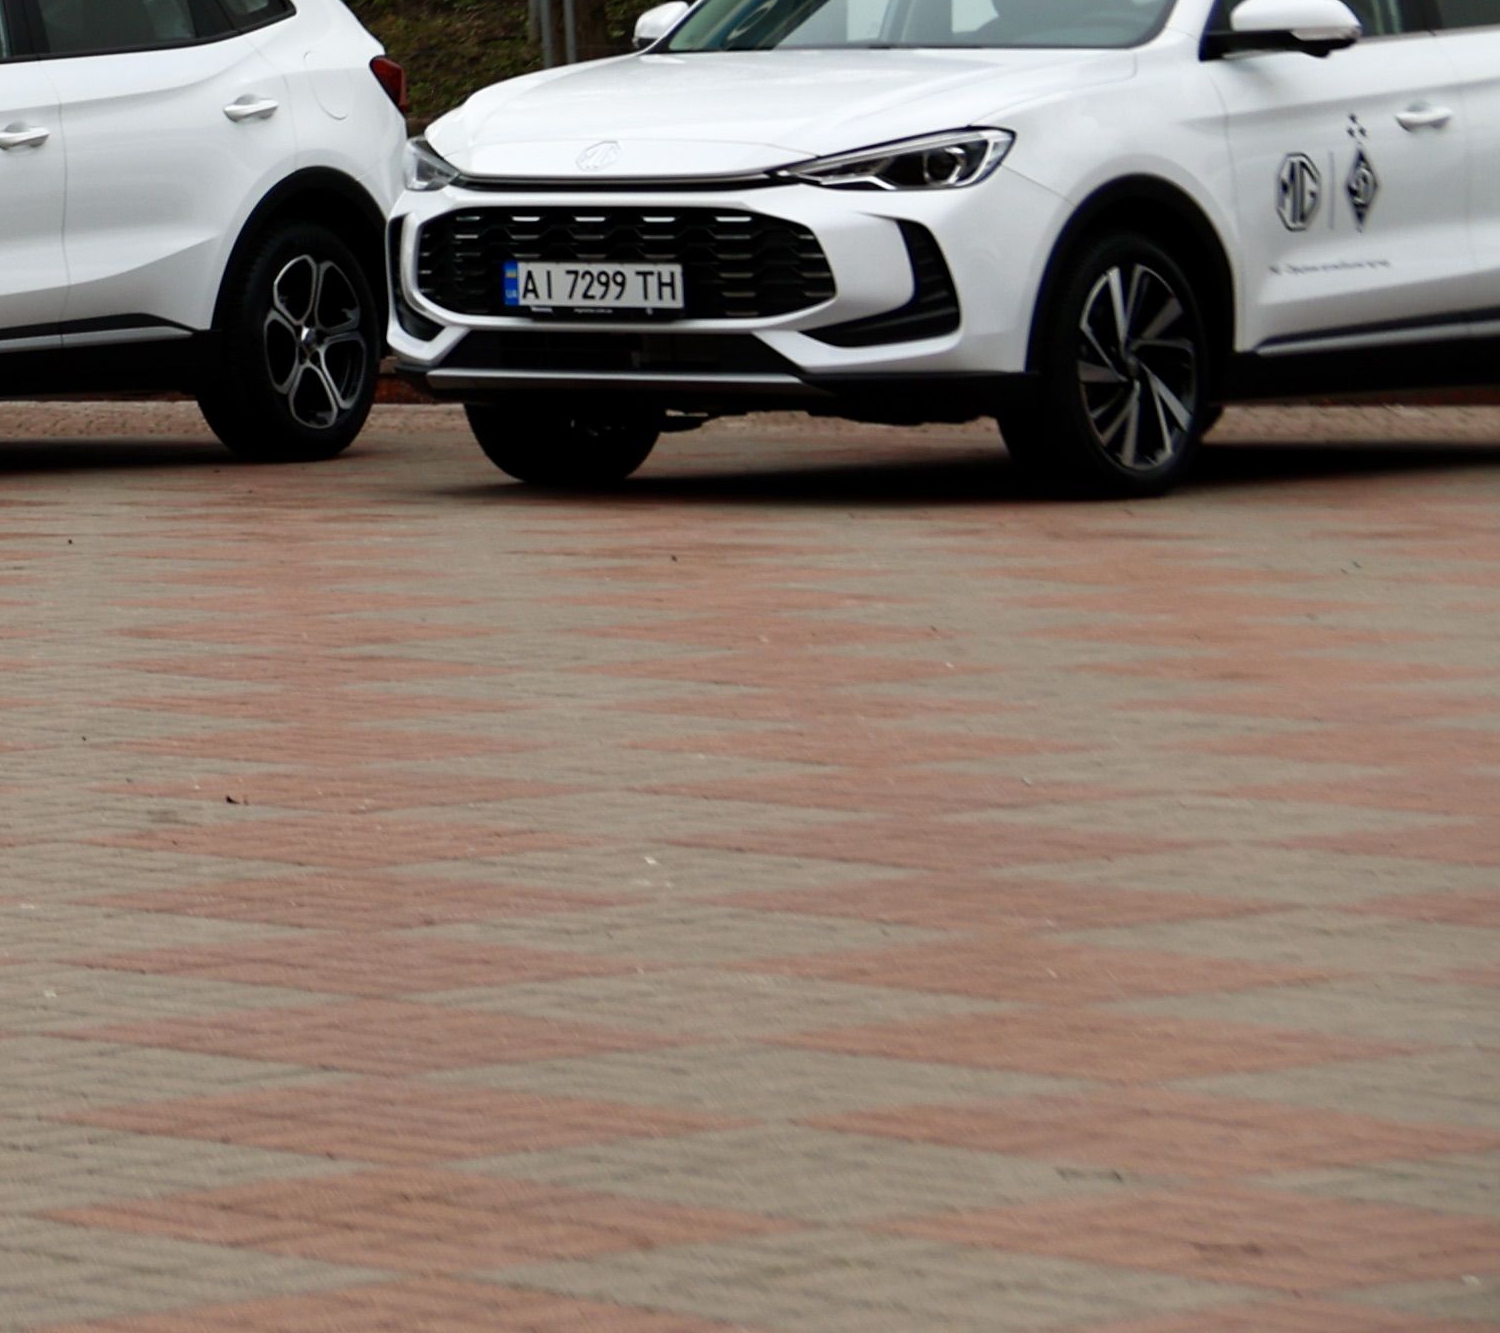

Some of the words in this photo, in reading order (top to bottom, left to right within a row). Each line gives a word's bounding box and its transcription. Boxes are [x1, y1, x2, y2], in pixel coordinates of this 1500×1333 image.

[522, 270, 552, 300] AI
[566, 270, 627, 301] 7299
[635, 270, 676, 301] TH
